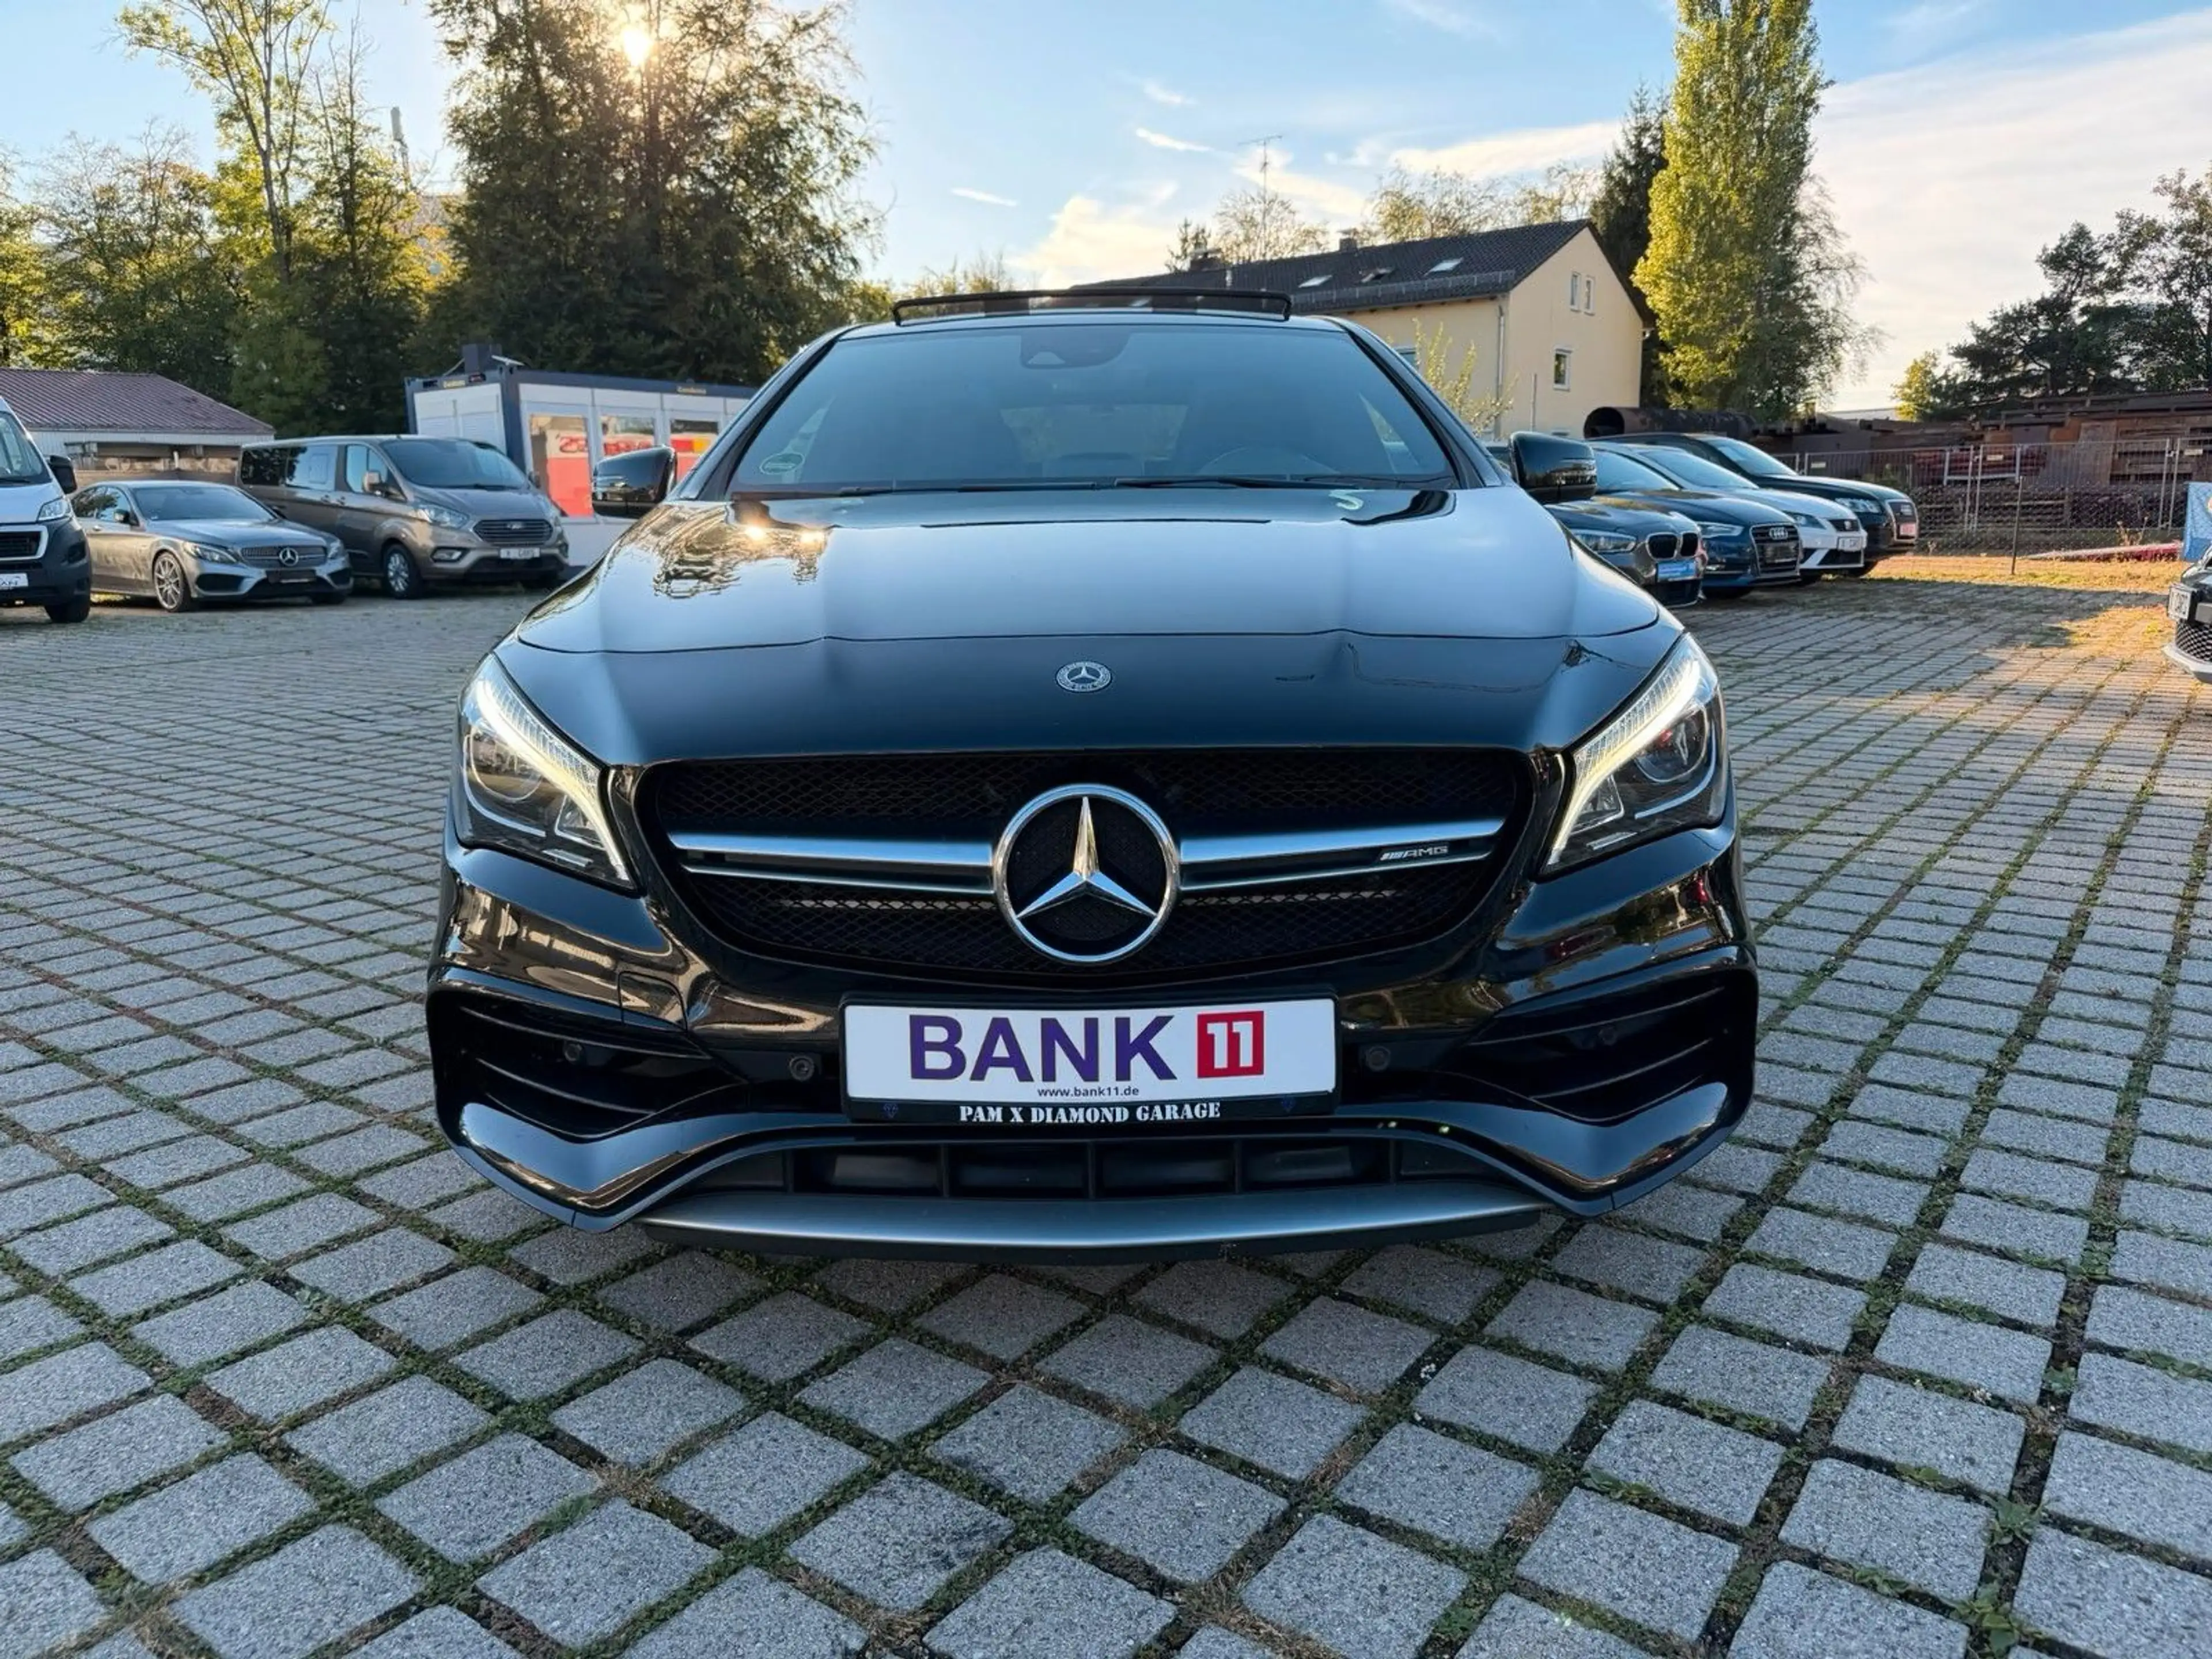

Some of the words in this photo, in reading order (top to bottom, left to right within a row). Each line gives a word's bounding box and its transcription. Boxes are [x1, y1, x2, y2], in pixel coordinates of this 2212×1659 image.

[1397, 845, 1449, 859] AMG
[909, 1014, 1177, 1082] BANK
[1207, 1021, 1253, 1069] 11
[1037, 1086, 1139, 1099] www.bank11.de
[960, 1105, 1003, 1123] PAM
[1010, 1107, 1024, 1122] X
[1031, 1106, 1130, 1124] DIAMOND
[1136, 1101, 1221, 1122] GARAGE
